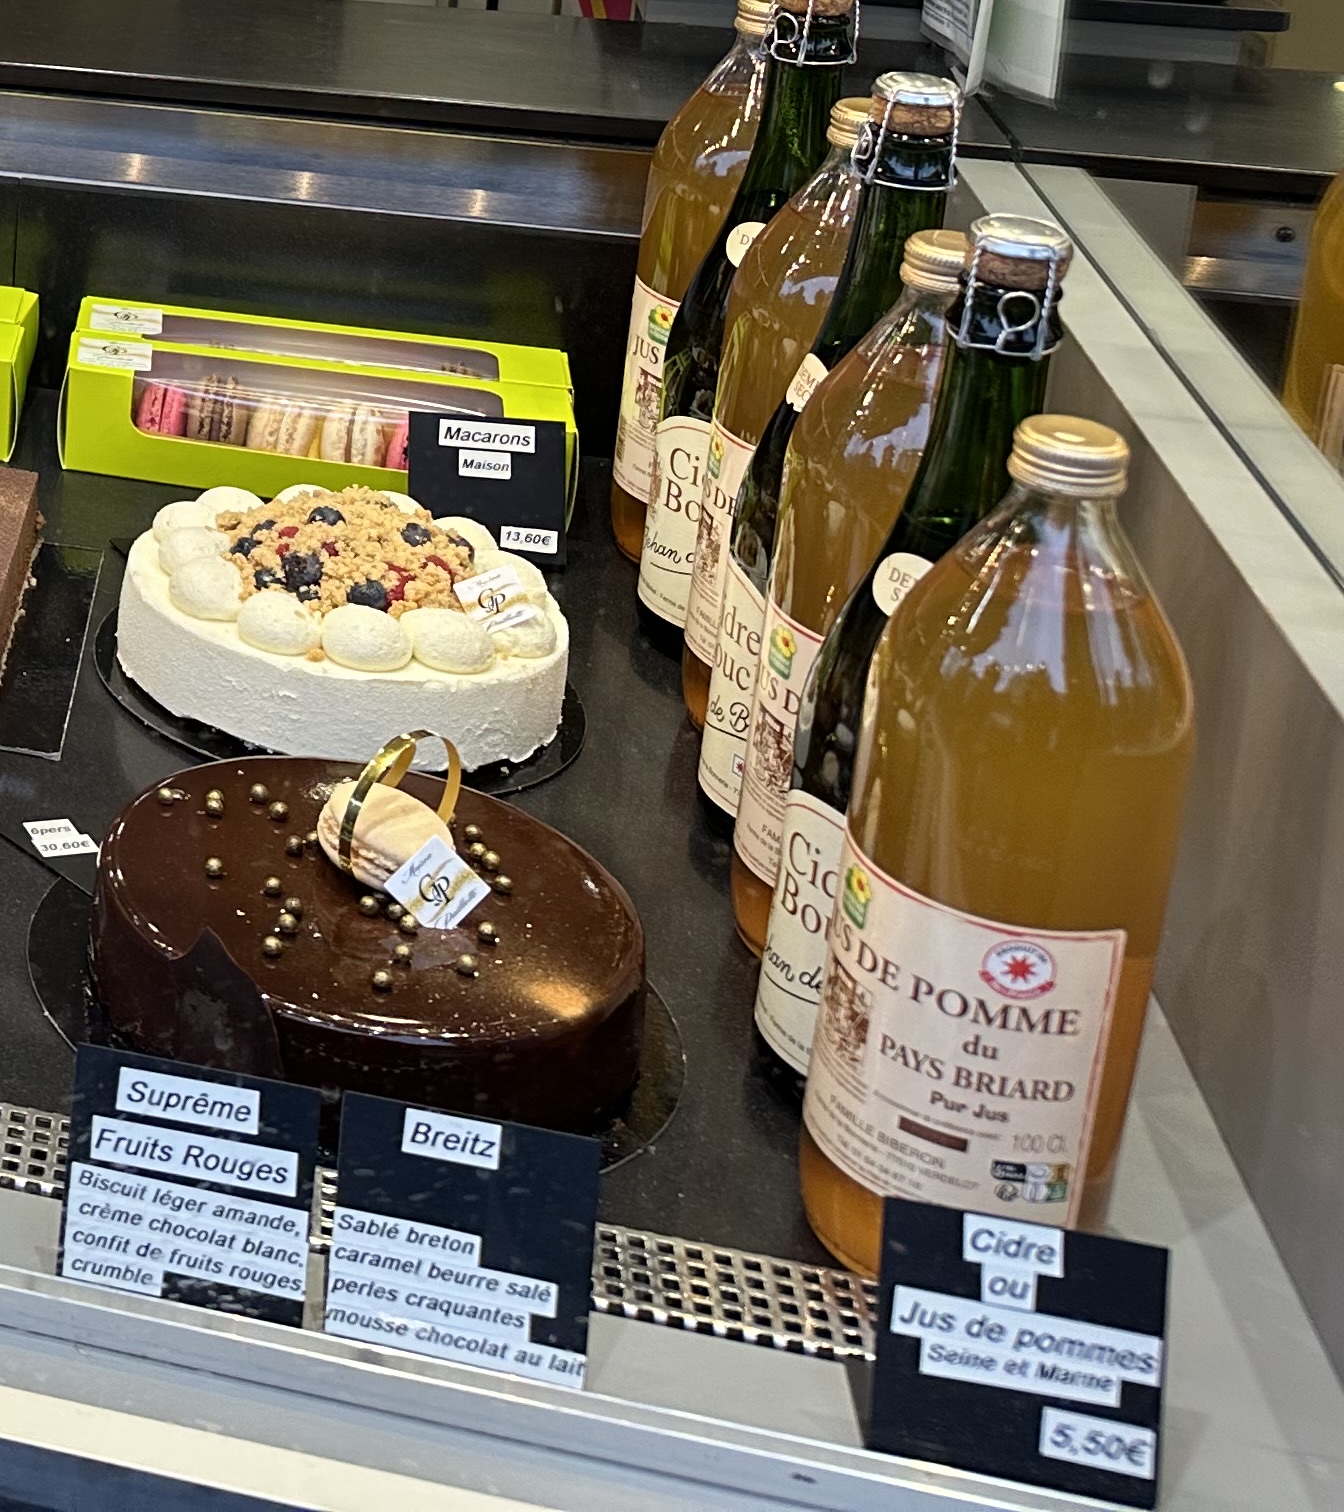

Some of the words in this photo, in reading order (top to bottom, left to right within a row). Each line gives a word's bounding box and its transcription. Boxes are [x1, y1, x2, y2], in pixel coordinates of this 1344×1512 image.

[633, 336, 660, 365] JUS
[444, 425, 532, 449] Macarons
[462, 457, 510, 474] Maison
[504, 530, 552, 548] 13,60€
[31, 826, 71, 836] 6pers
[856, 939, 901, 991] DE
[909, 973, 1081, 1037] POMME
[879, 1032, 946, 1081] PAYS
[952, 1065, 1075, 1103] BRIARD
[962, 1034, 999, 1060] du
[125, 1081, 252, 1124] Suprême
[929, 1090, 967, 1113] Pur
[973, 1103, 1009, 1124] Jus
[94, 1129, 174, 1163] Fruits
[181, 1146, 289, 1186] Rouges
[409, 1122, 496, 1160] Breitz
[1014, 1133, 1043, 1153] 100
[78, 1169, 146, 1200] Biscuit
[152, 1187, 205, 1216] léger
[211, 1202, 302, 1237] amande,
[78, 1200, 143, 1226] crème
[149, 1218, 236, 1248] chocolat
[338, 1211, 400, 1240] Sablé
[406, 1226, 475, 1256] breton
[970, 1228, 1057, 1265] Cidre
[70, 1255, 154, 1286] crumble
[71, 1228, 131, 1255] confit
[136, 1240, 163, 1262] de
[168, 1249, 224, 1276] fruits
[229, 1265, 306, 1296] rouges,
[334, 1244, 421, 1273] caramel
[428, 1262, 500, 1292] beurre
[506, 1279, 552, 1303] salé
[331, 1275, 400, 1304] perles
[406, 1287, 526, 1330] craquantes
[988, 1275, 1031, 1300] ou
[327, 1307, 409, 1337] mousse
[415, 1323, 509, 1361] chocolat
[514, 1347, 543, 1365] au
[548, 1351, 586, 1377] lait
[899, 1300, 956, 1333] Jus
[965, 1314, 1007, 1343] de
[1013, 1327, 1156, 1375] pommes
[927, 1343, 997, 1373] Seine
[1003, 1357, 1031, 1377] et
[1036, 1362, 1114, 1393] Marne
[1049, 1423, 1149, 1467] 5,50€
